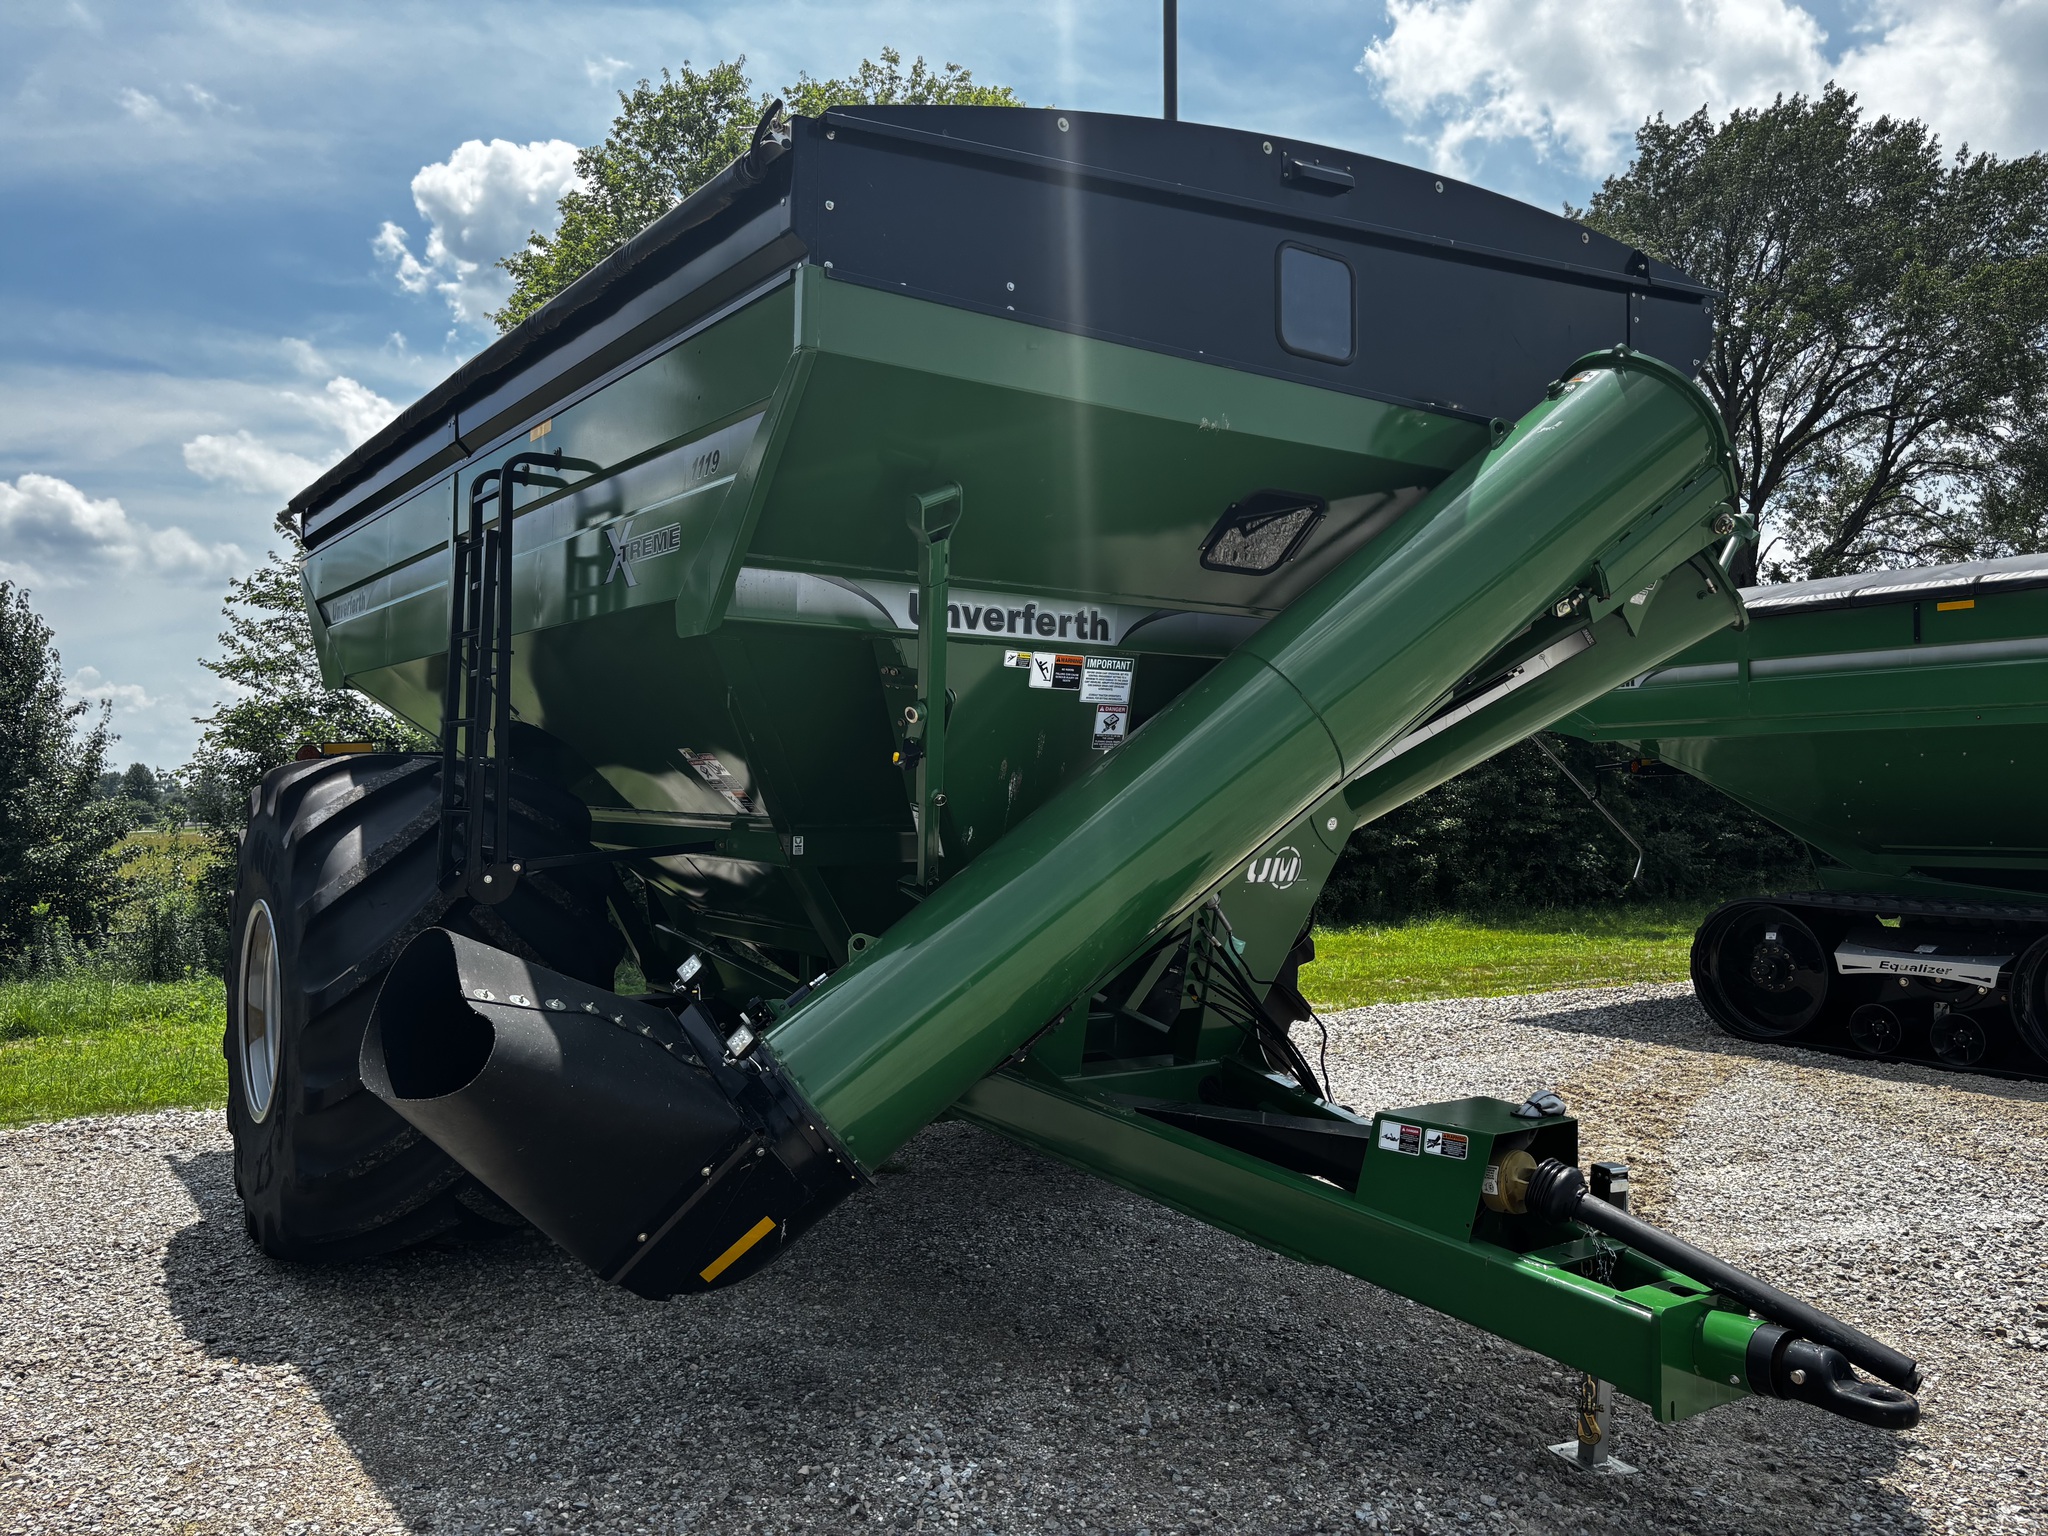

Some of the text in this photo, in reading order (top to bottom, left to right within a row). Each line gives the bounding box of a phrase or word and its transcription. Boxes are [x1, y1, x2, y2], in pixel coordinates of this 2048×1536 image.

[691, 449, 720, 480] 1119
[1086, 658, 1131, 671] IMPORTANT
[1879, 960, 1953, 975] Equalizer
